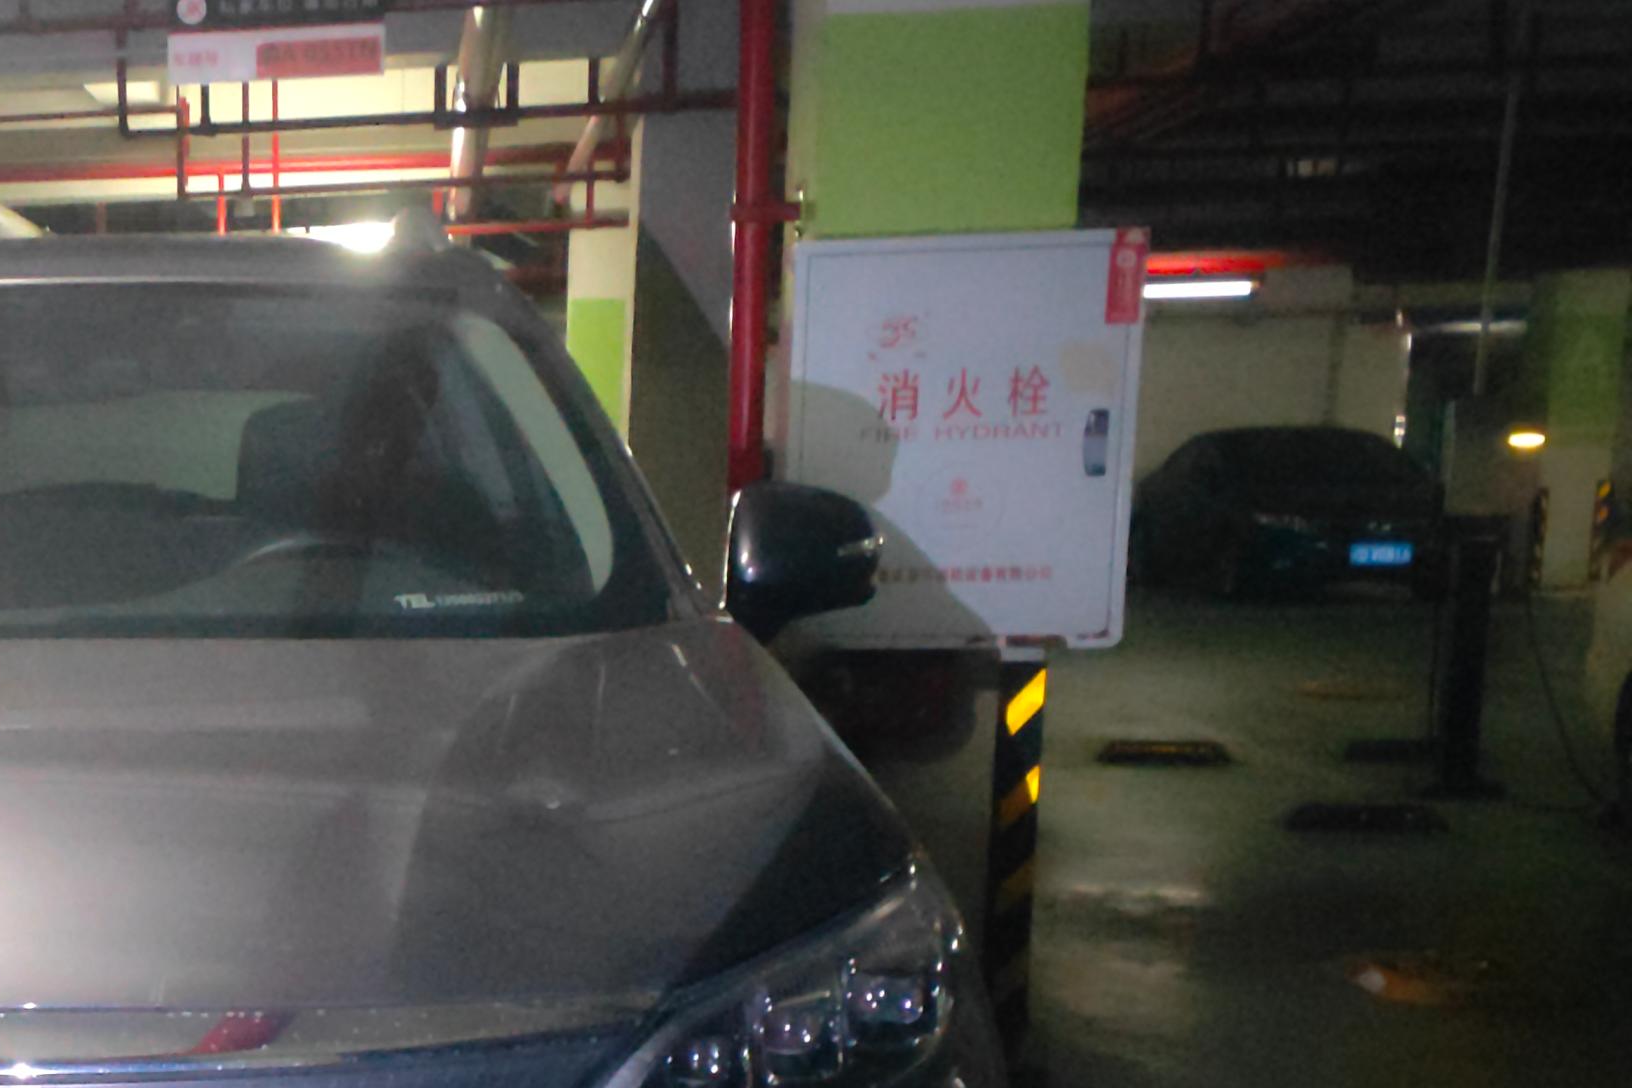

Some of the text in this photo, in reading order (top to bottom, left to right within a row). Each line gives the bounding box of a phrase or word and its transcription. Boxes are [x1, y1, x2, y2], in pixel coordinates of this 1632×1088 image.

[878, 364, 1050, 421] 消火栓
[935, 420, 1063, 441] HYDRANT
[394, 593, 435, 609] TEL
